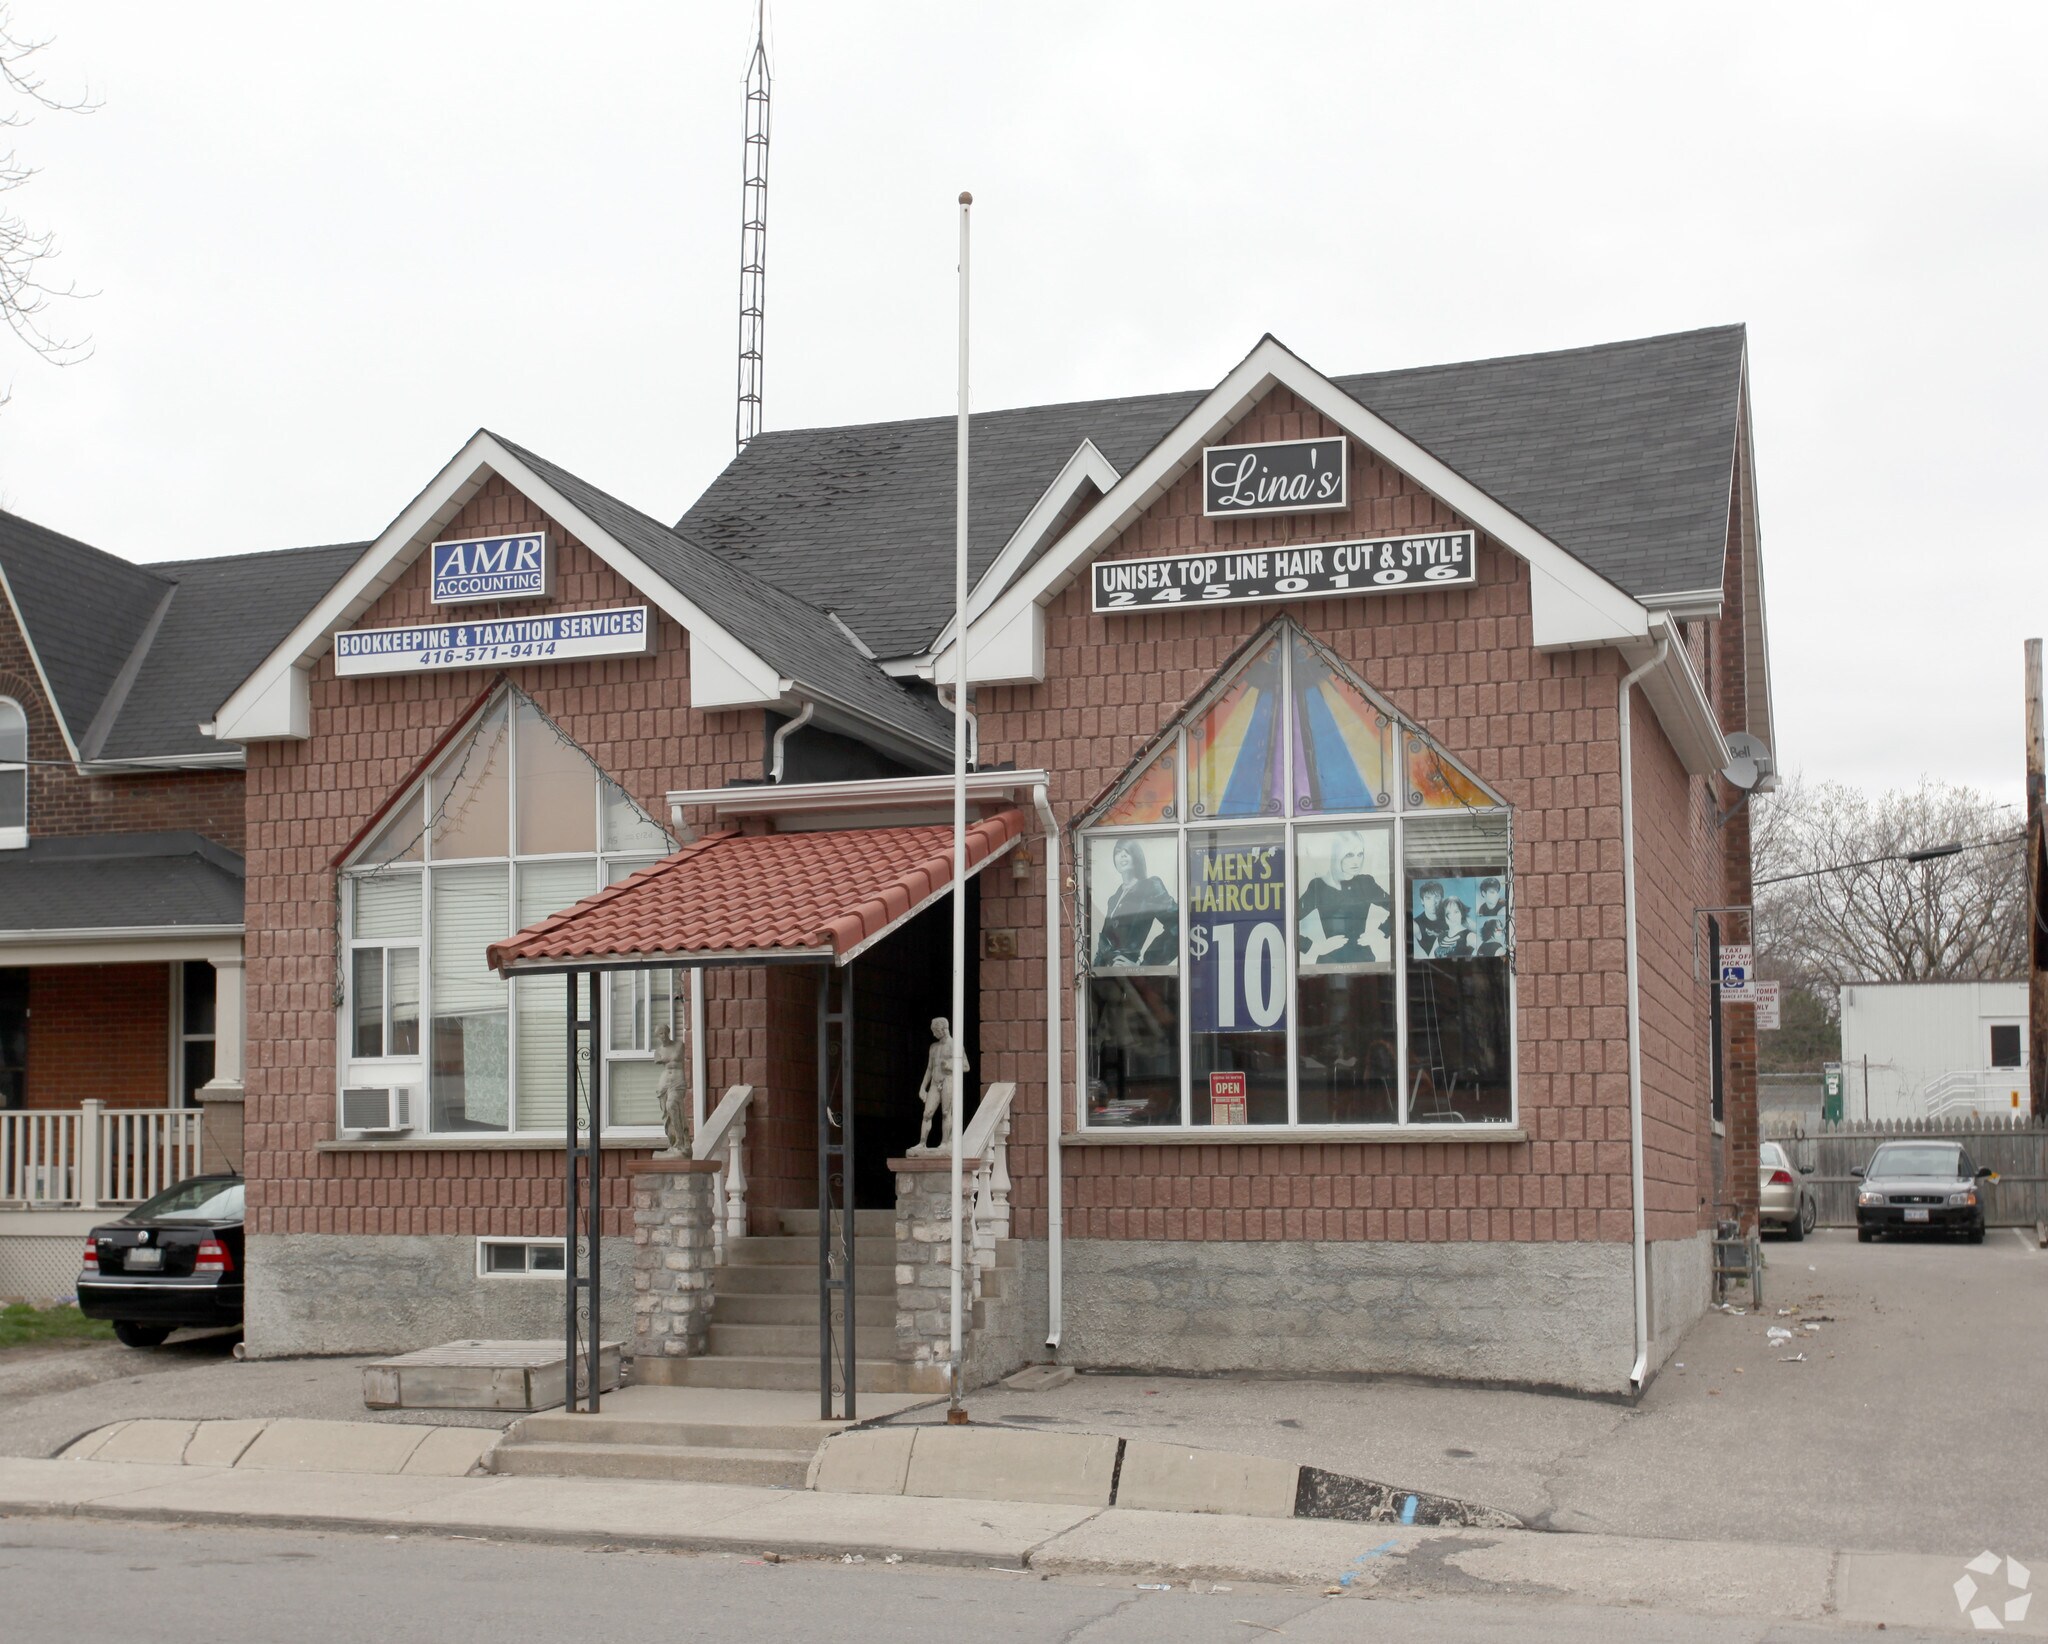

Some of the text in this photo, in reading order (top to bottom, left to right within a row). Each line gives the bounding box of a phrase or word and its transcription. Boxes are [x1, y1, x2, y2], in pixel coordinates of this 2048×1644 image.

[1211, 447, 1340, 506] Lina's
[438, 539, 540, 577] AMR
[1102, 537, 1463, 592] UNISEX TOP LINE HAIR CUT & STYLE
[437, 573, 540, 595] ACCOUNTING
[339, 612, 642, 655] BOOKKEEPING & TAXATION SERVICES
[420, 642, 556, 664] 416-571-9414
[1730, 745, 1751, 758] Bell
[1203, 850, 1272, 881] MEN'S
[1188, 882, 1284, 912] HAIRCUT
[1215, 1082, 1240, 1094] OPEN
